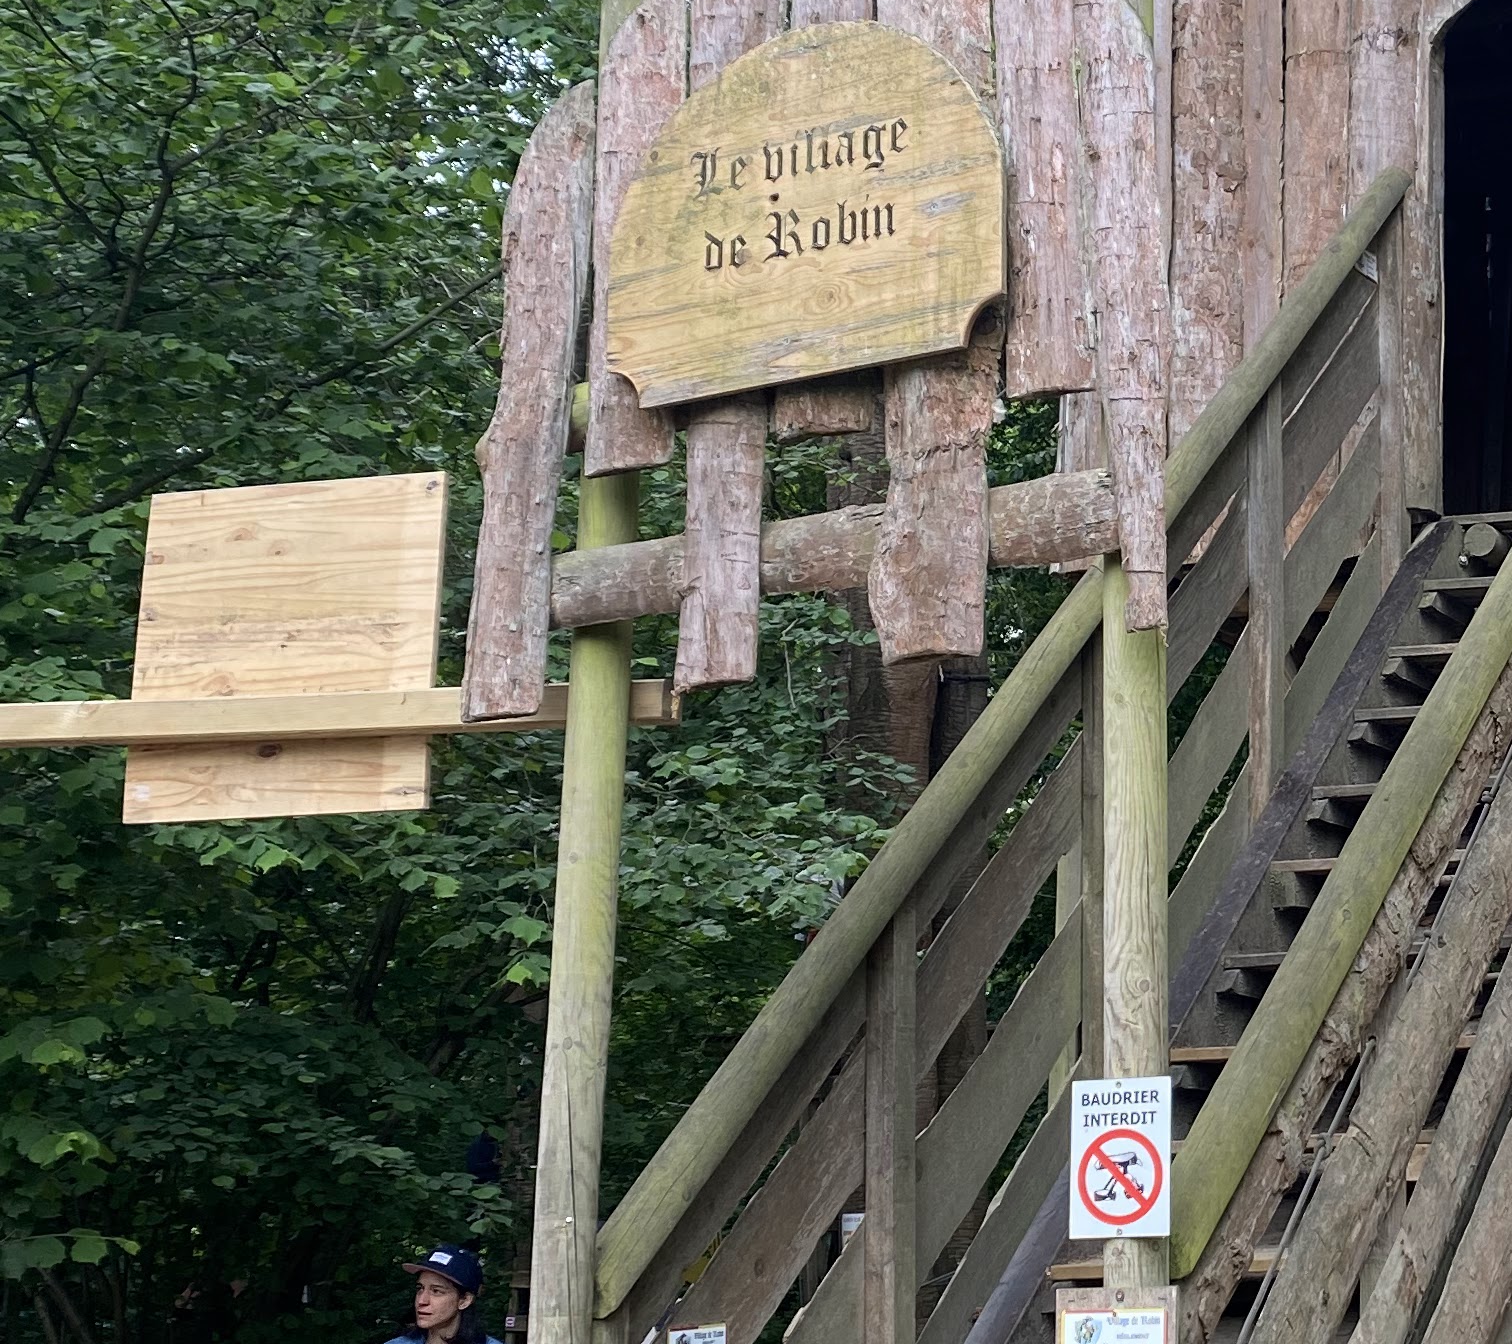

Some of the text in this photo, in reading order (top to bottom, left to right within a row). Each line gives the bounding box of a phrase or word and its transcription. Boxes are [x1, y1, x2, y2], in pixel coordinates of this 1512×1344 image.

[690, 116, 909, 201] Le village
[703, 193, 897, 272] de Robin
[1081, 1090, 1160, 1107] BAUDRIER
[1083, 1110, 1157, 1128] INTERDIT
